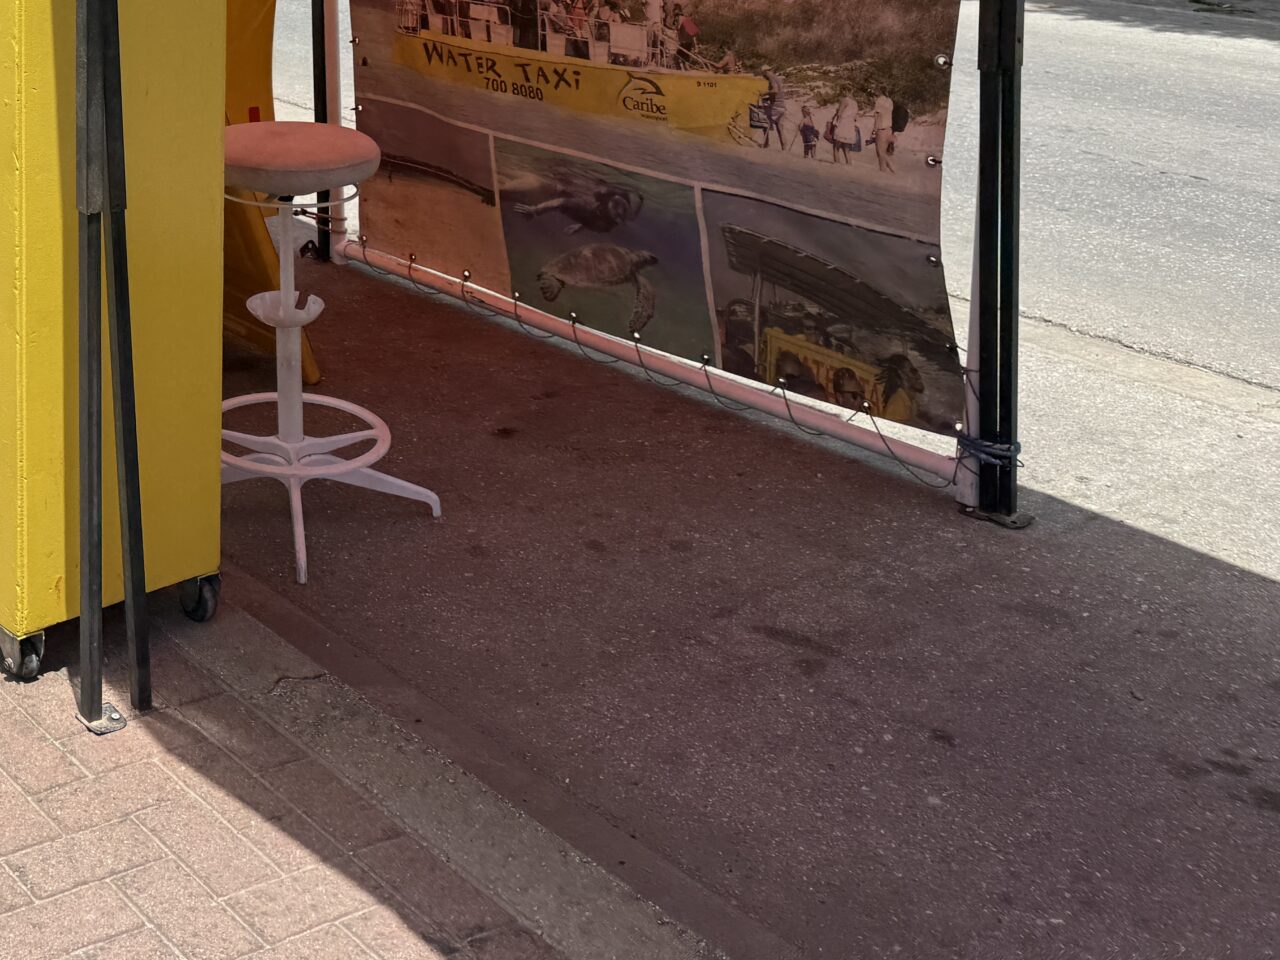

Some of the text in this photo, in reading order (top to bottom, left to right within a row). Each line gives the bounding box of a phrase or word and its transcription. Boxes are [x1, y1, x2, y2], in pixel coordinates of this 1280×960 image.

[422, 41, 502, 79] WATER
[484, 76, 544, 102] 700 8080
[622, 96, 668, 116] Caribe
